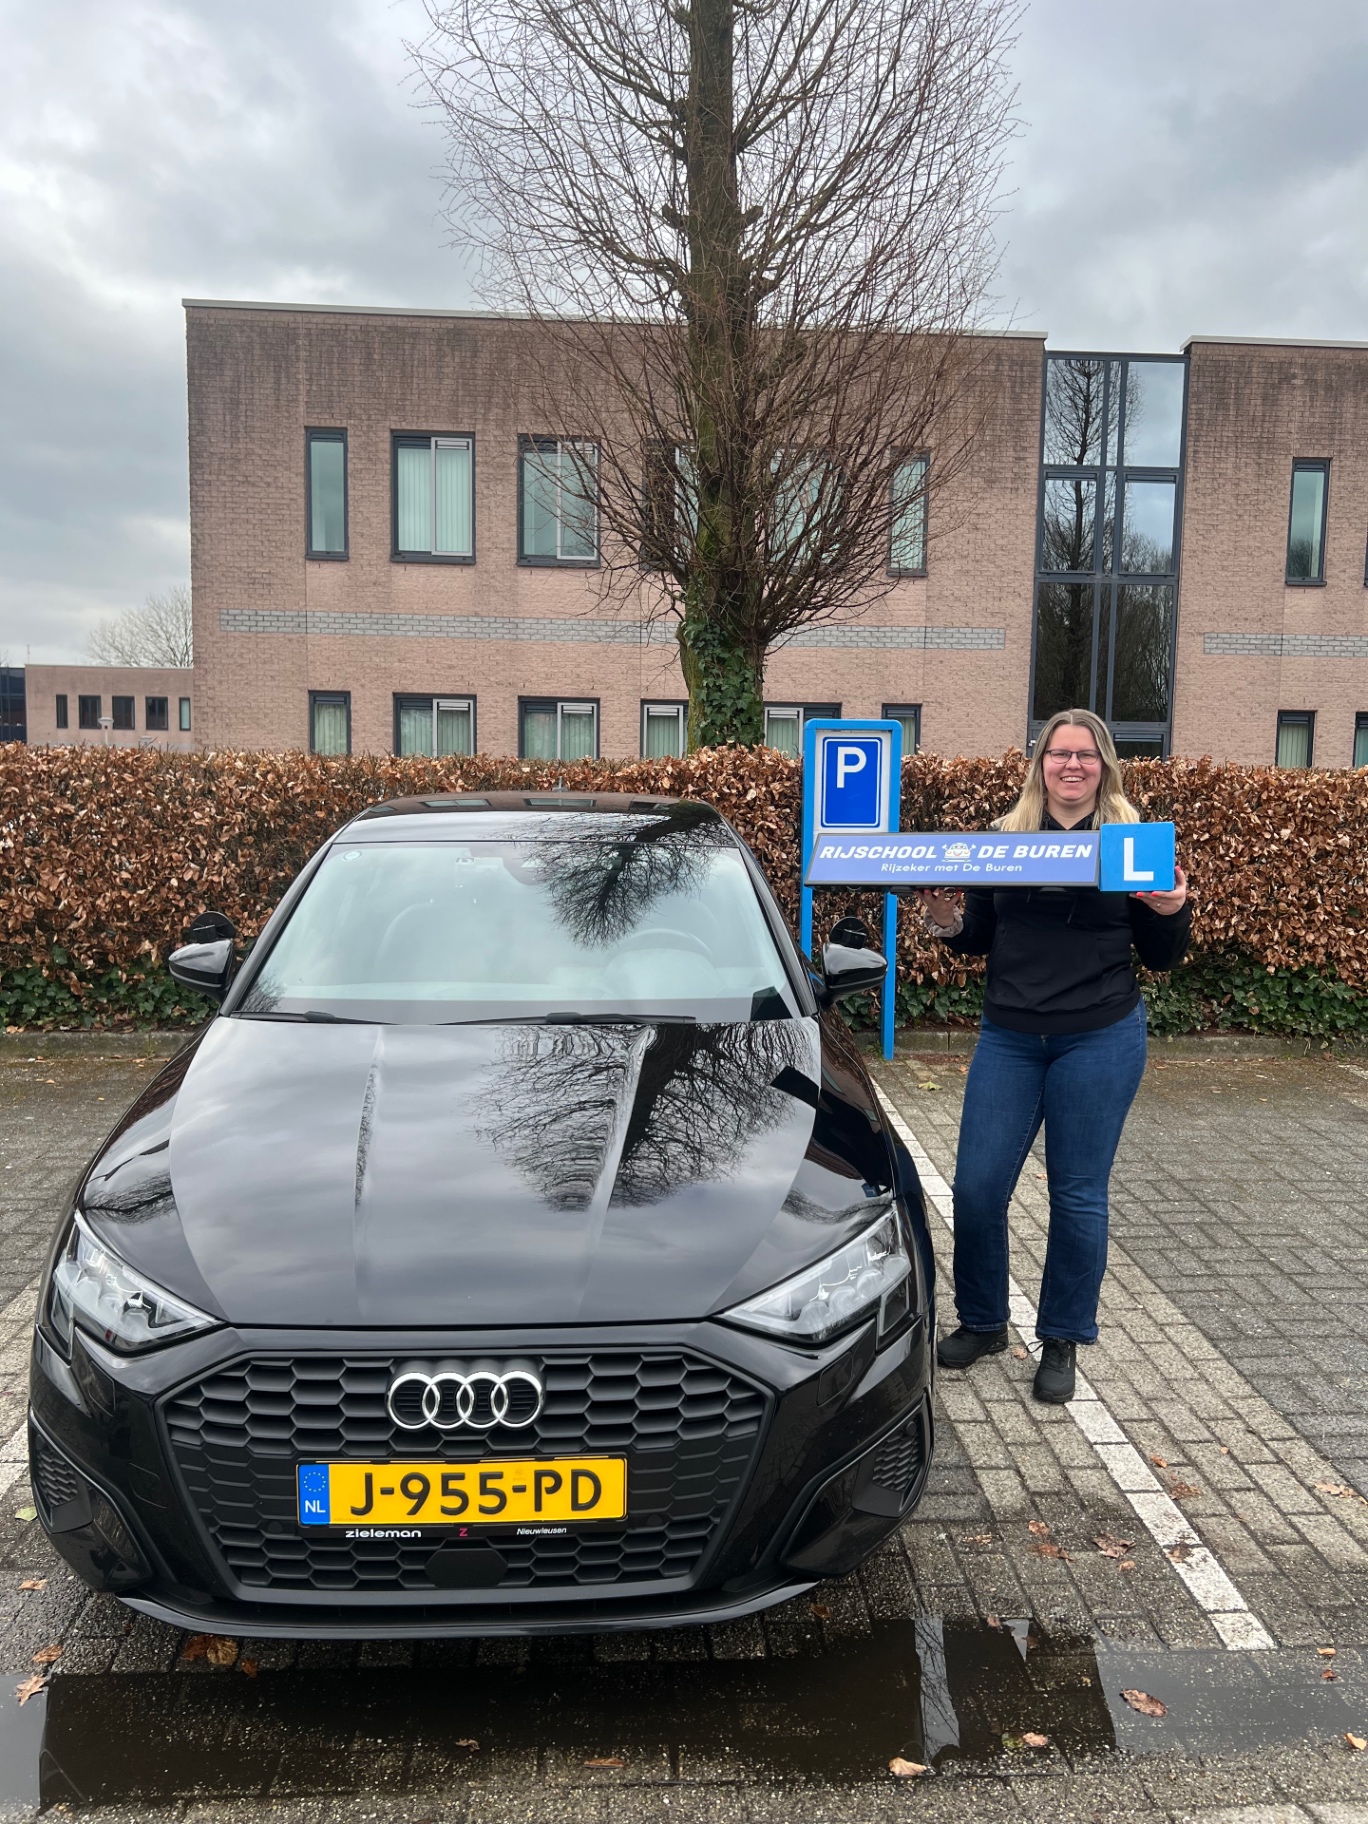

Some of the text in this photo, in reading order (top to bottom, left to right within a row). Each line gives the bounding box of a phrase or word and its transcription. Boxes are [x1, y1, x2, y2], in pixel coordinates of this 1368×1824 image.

[836, 746, 867, 788] P
[820, 843, 1093, 859] RIJSCHOOL DE BUREN
[1123, 837, 1154, 881] L
[881, 862, 1022, 874] Rijzeker met De Buren
[350, 1468, 602, 1516] J-955-PD
[305, 1499, 326, 1513] NL
[345, 1528, 421, 1538] zieleman
